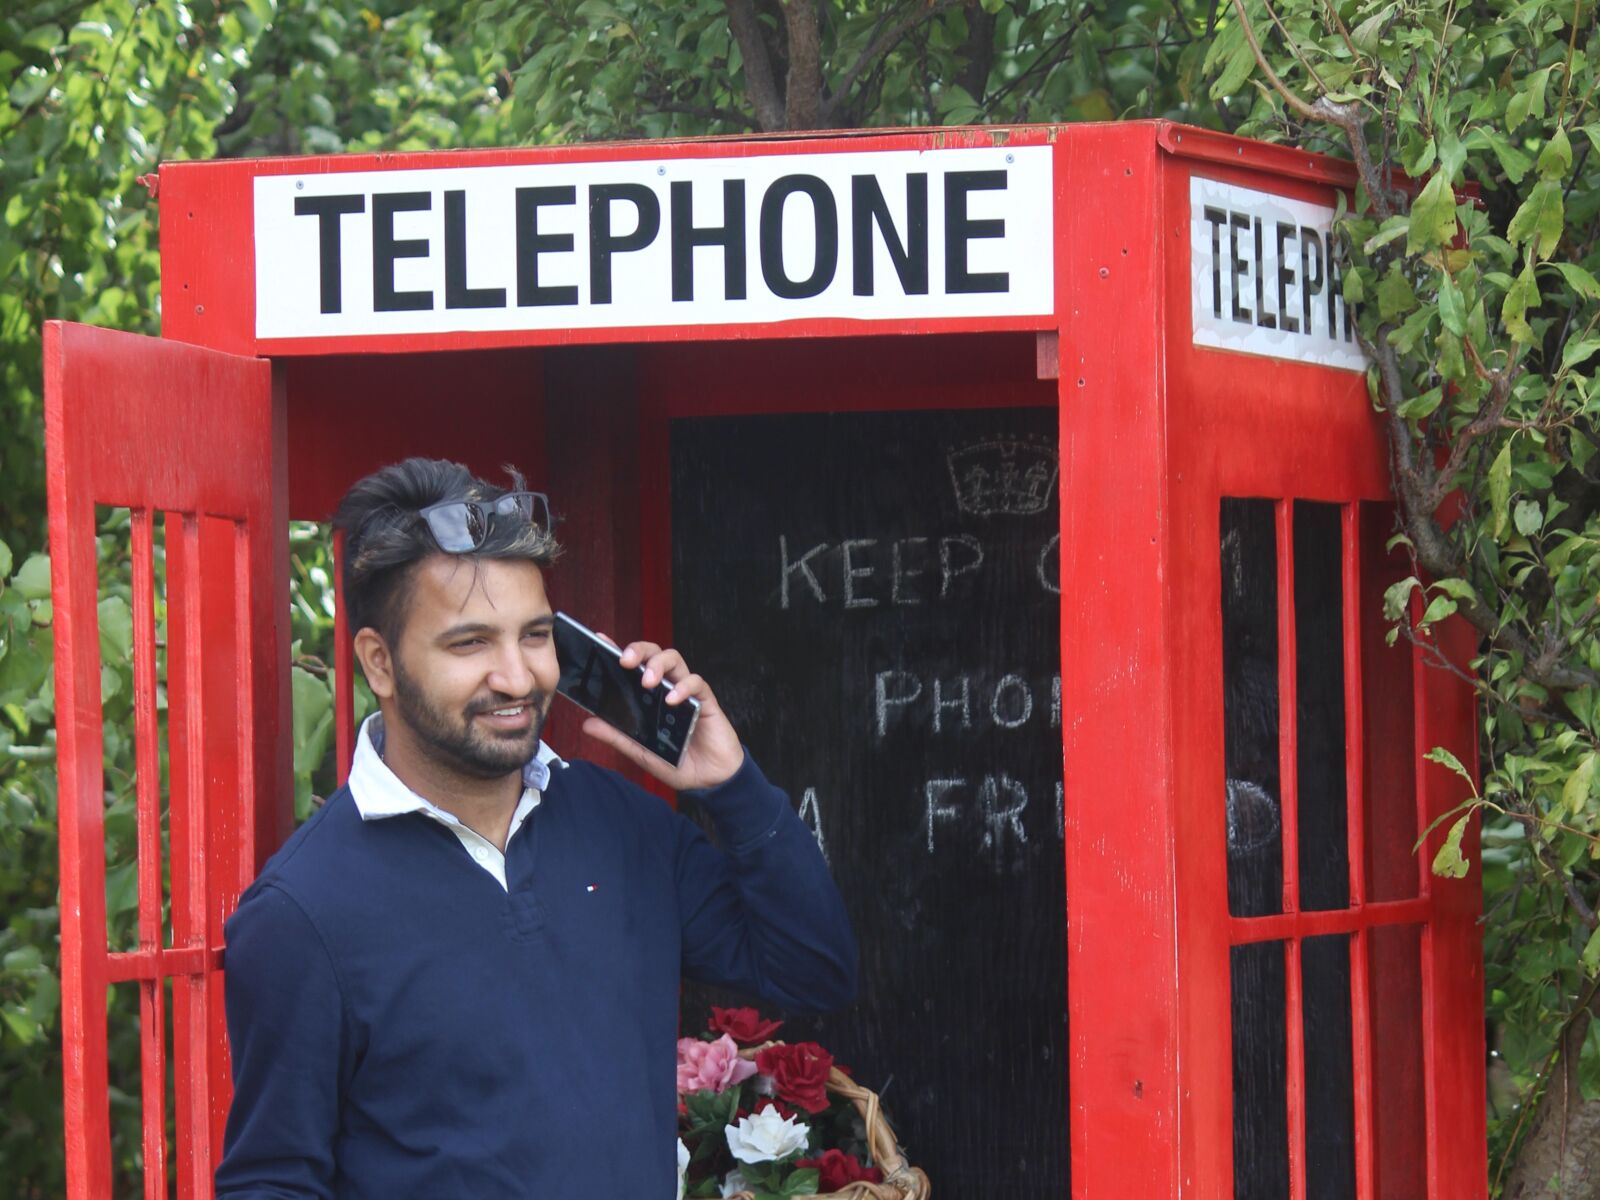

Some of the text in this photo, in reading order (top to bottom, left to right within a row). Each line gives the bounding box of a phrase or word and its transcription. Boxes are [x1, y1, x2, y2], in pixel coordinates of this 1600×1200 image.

[294, 169, 1010, 314] TELEPHONE
[1204, 204, 1353, 343] TELEPH
[779, 533, 984, 609] KEEP
[875, 669, 1061, 737] PHO
